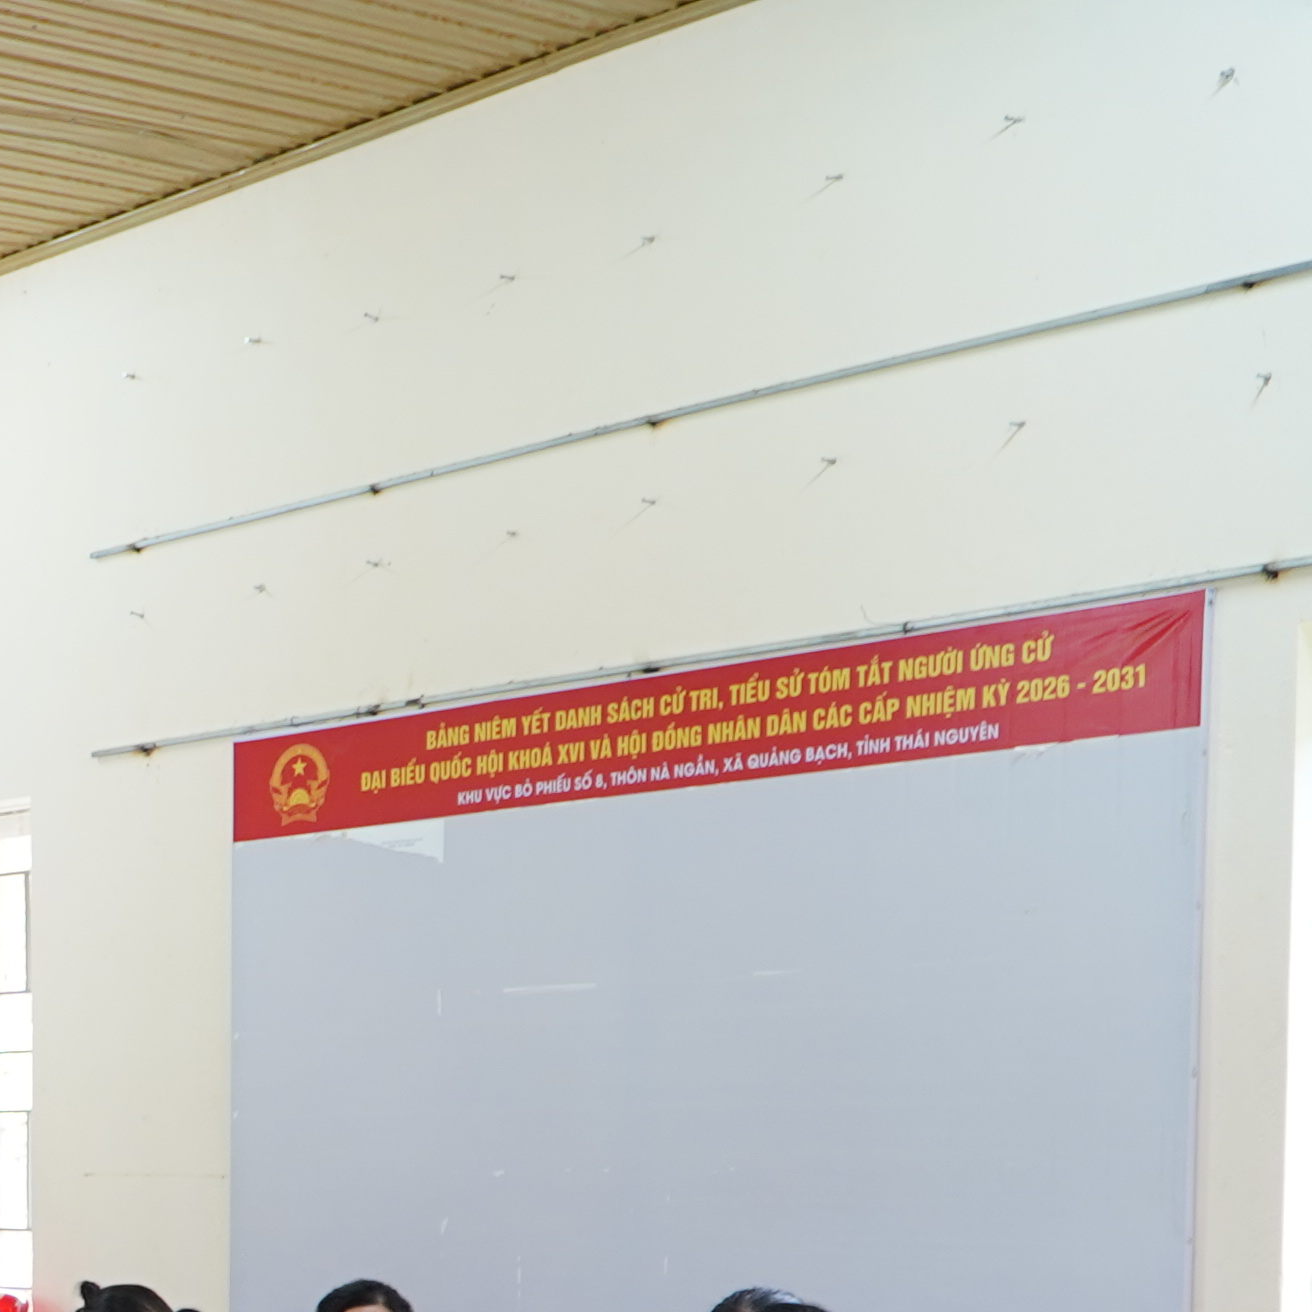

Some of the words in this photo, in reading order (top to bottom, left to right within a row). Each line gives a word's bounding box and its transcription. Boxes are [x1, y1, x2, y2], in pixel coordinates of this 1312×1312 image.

[360, 769, 386, 794] ĐẠI
[390, 757, 426, 787] BIỂU
[429, 751, 472, 784] QUỐC
[476, 749, 504, 778] HỘI
[508, 742, 553, 771] KHOÁ
[557, 741, 585, 765] XVI
[589, 733, 613, 760] VÀ
[617, 729, 648, 759] HỘI
[652, 720, 702, 752] ĐỒNG
[707, 715, 761, 745] NHÂN
[765, 708, 808, 737] DÂN
[812, 701, 853, 731] CÁC
[858, 691, 900, 725] CẤP
[906, 685, 976, 719] NHIỆM
[1015, 674, 1071, 705] 2026
[1092, 663, 1146, 695] 2031
[426, 722, 470, 750] BẢNG
[474, 715, 517, 743] NIÊM
[521, 707, 551, 735] YẾT
[555, 705, 603, 731] DANH
[606, 696, 655, 723] SÁCH
[659, 686, 687, 716] CỬ
[689, 687, 724, 711] TRI,
[729, 672, 770, 706] TIỂU
[776, 667, 805, 699] SỬ
[807, 665, 851, 695] TÓM
[856, 654, 893, 687] TẮT
[897, 646, 963, 682] NGƯỜI
[970, 642, 1015, 671] ỨNG
[1021, 630, 1055, 664] CỬ
[457, 788, 483, 806] KHU
[485, 784, 512, 805] VỰC
[514, 778, 533, 797] BỎ
[535, 772, 571, 796] PHIẾU
[574, 768, 594, 791] SỐ
[610, 765, 648, 787] THÔN
[722, 752, 744, 774] XÃ
[747, 746, 802, 769] QUẢNG
[805, 741, 852, 765] BẠCH,
[856, 734, 891, 756] TỈNH
[894, 728, 930, 751] THÁI
[933, 720, 1000, 747] NGUYÊN
